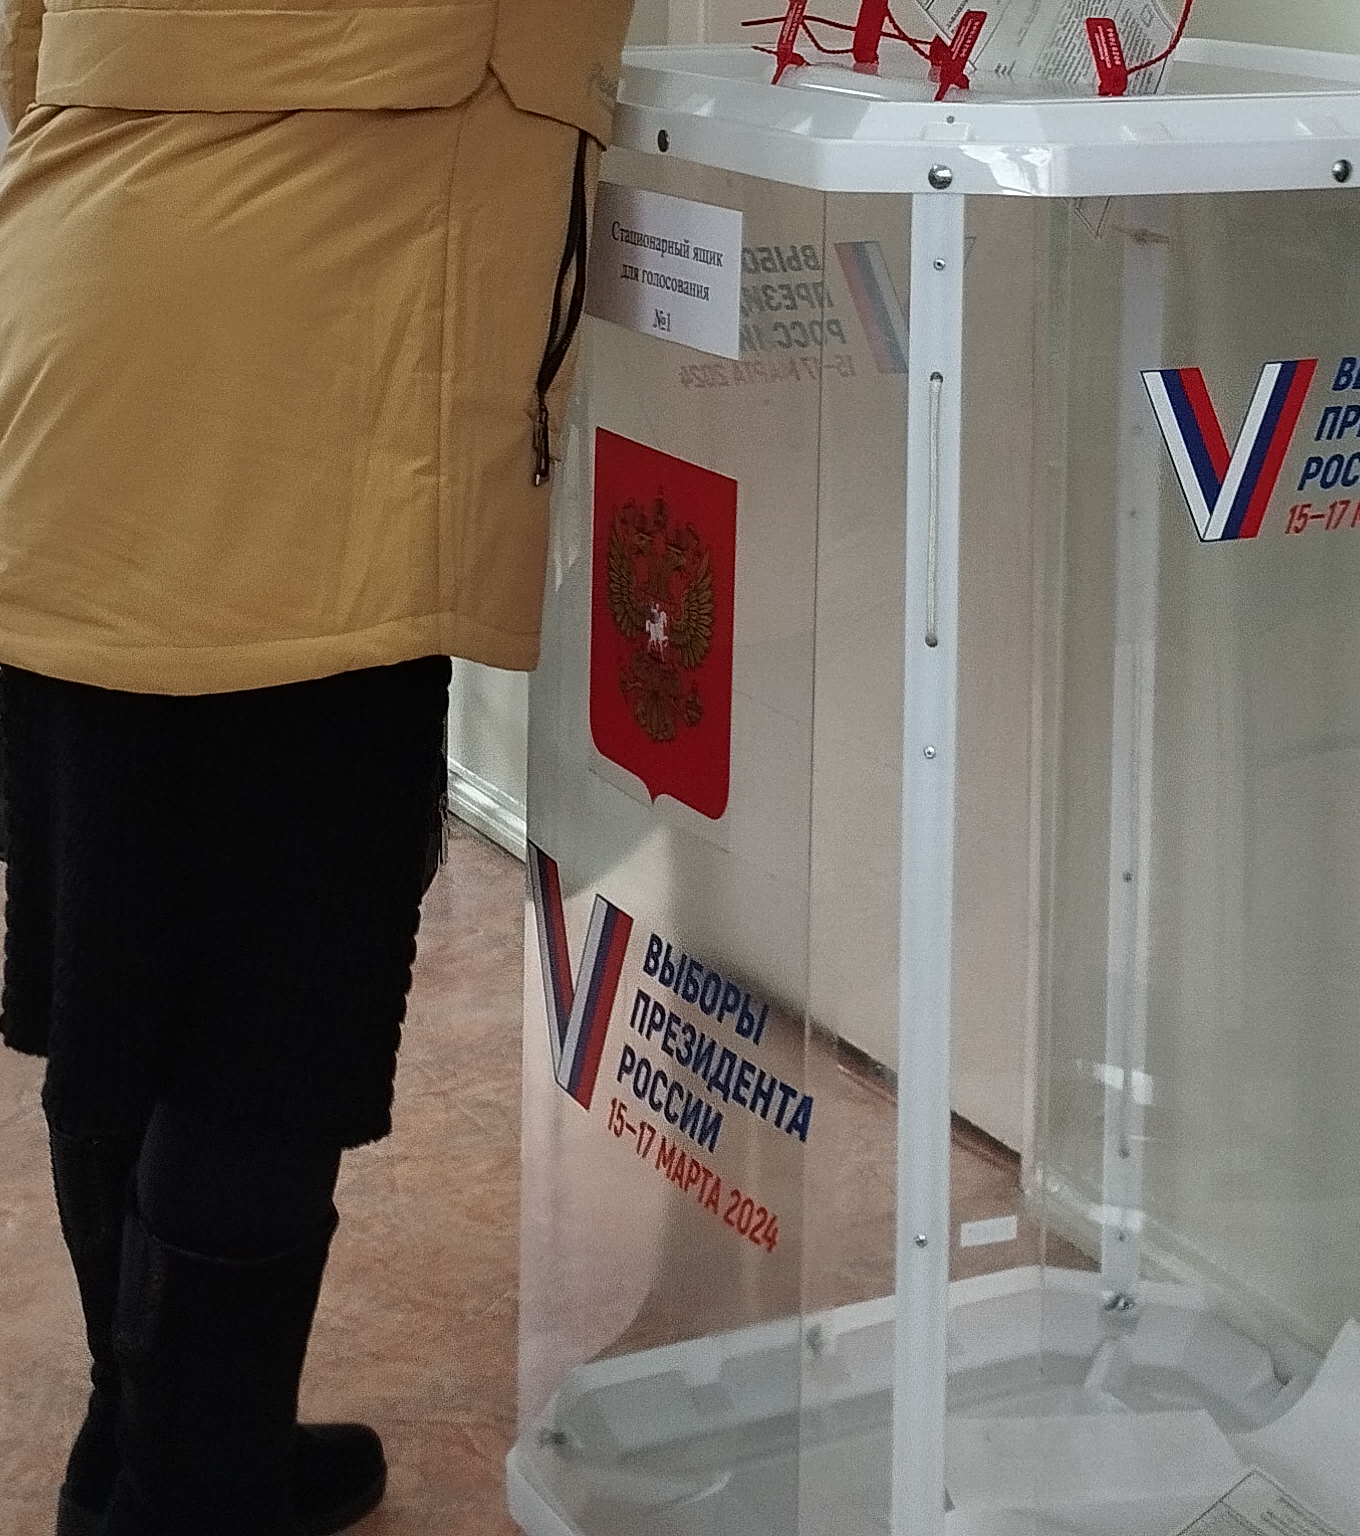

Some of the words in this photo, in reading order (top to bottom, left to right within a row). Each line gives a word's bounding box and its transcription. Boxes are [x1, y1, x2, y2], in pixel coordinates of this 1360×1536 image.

[611, 221, 690, 260] Стационарный
[693, 246, 724, 268] ящик
[621, 264, 639, 282] для
[641, 269, 710, 302] голосования
[642, 932, 771, 1047] ВЫБОРЫ
[616, 1043, 724, 1154] РОССИИ
[629, 987, 815, 1144] ПРЕЗИДЕНТА
[654, 1136, 723, 1215] МАРТА
[722, 1188, 780, 1254] 2024
